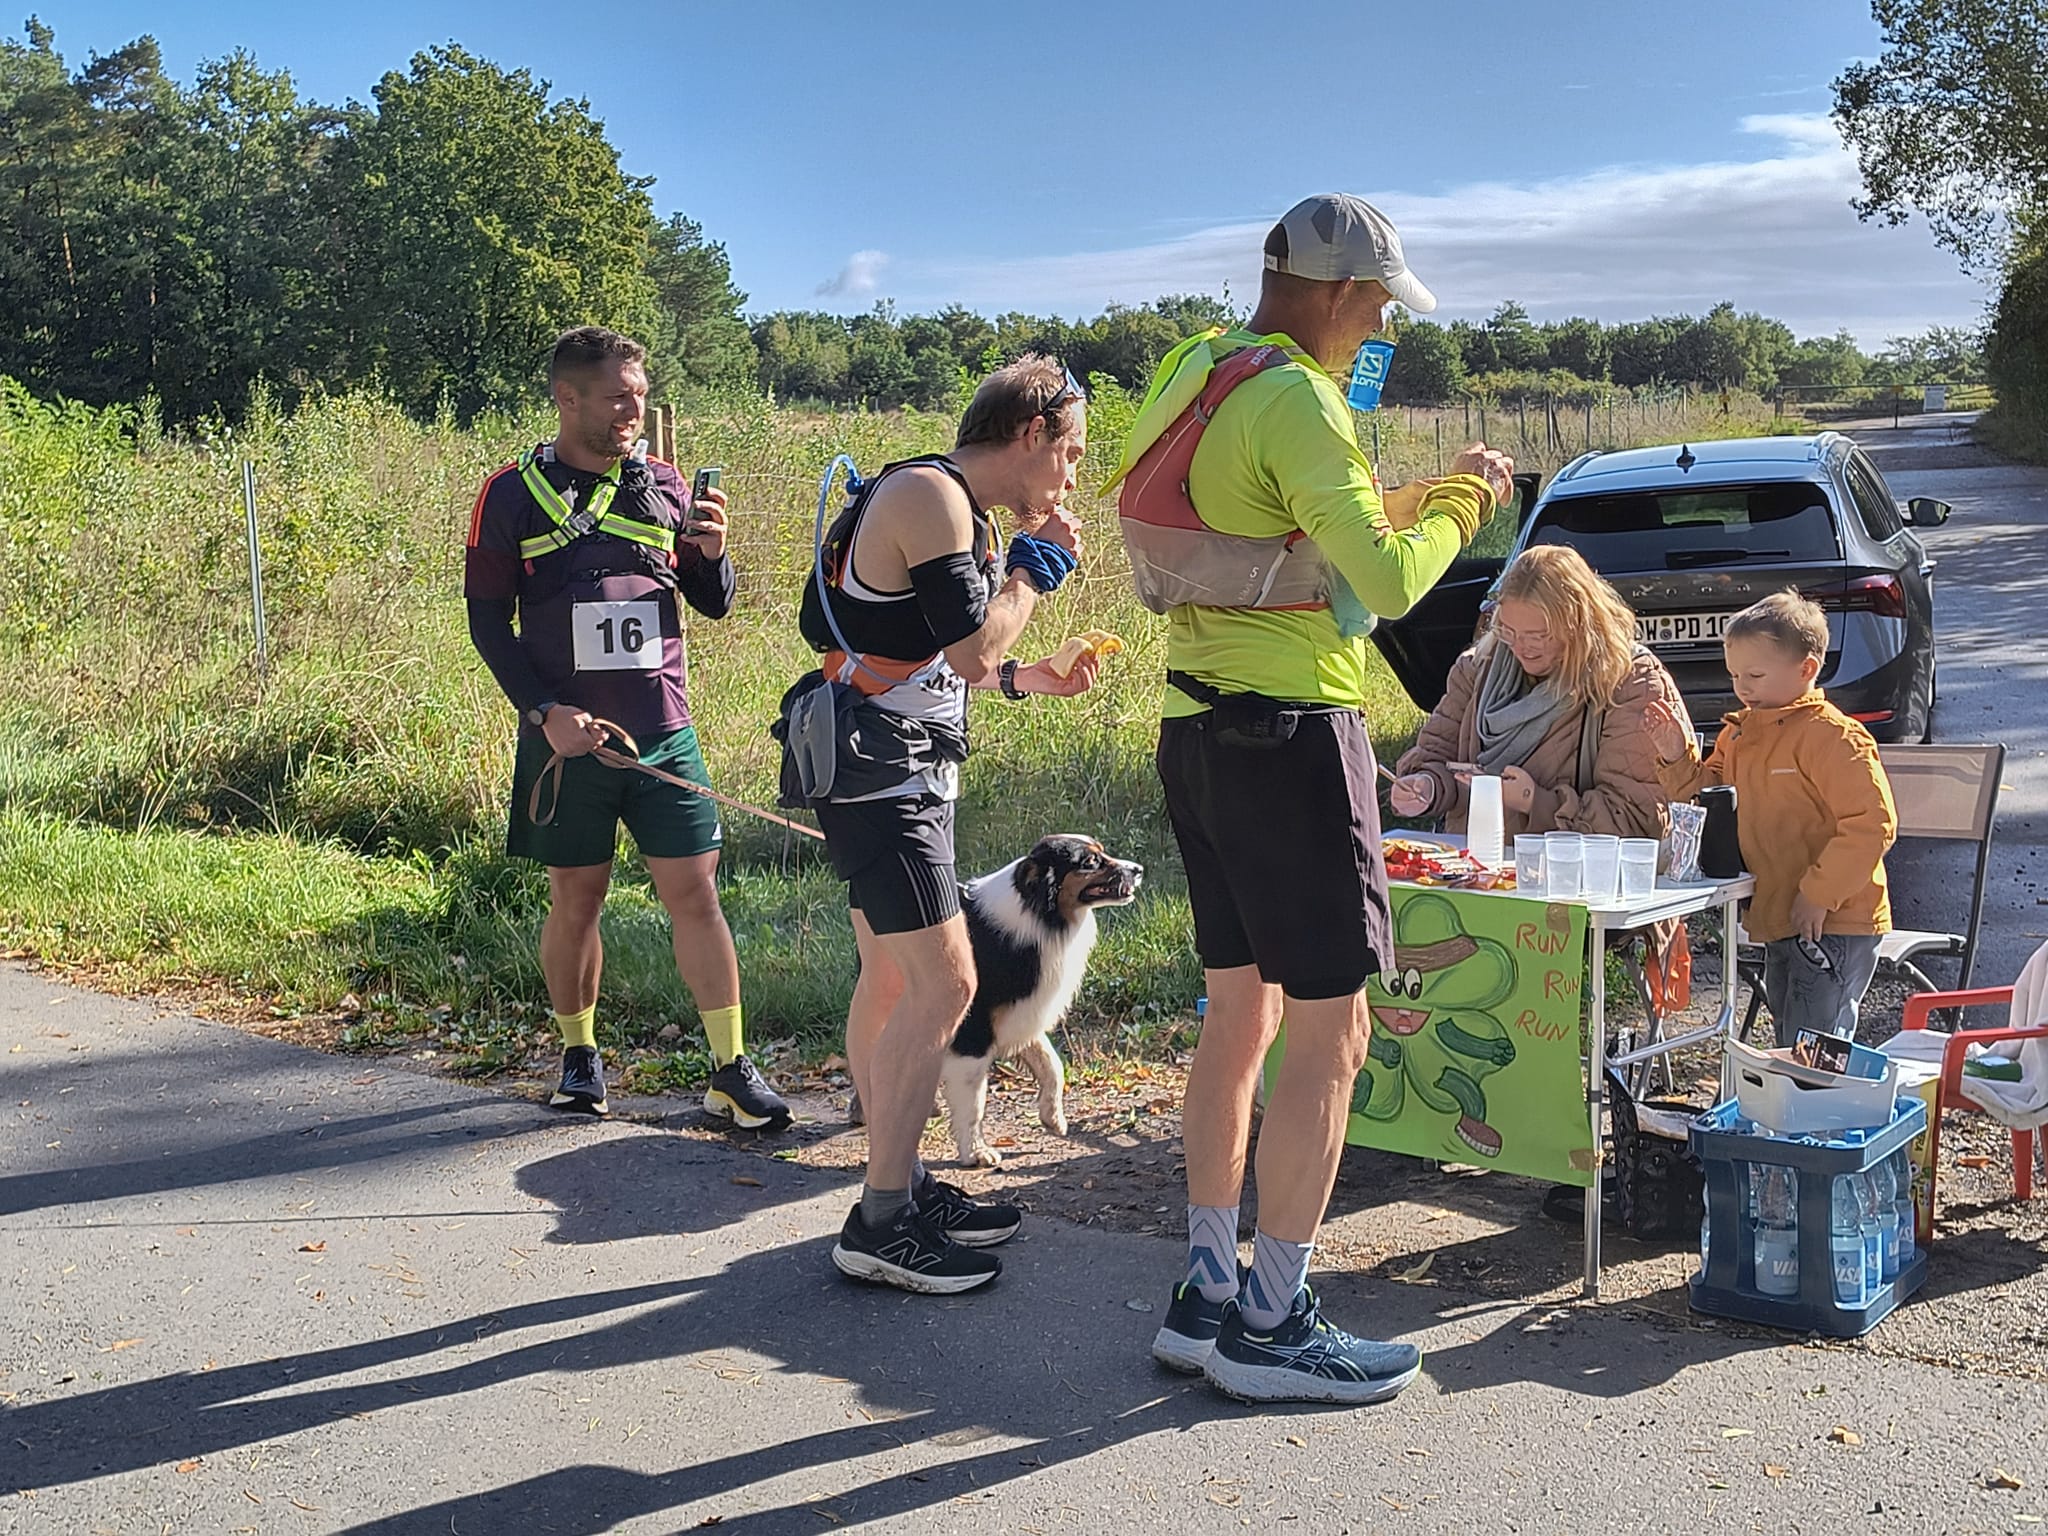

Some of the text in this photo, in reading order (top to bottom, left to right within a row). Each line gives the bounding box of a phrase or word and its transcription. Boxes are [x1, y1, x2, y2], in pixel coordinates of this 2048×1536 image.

[596, 617, 644, 655] 16
[1674, 617, 1700, 640] PD
[1516, 923, 1570, 957] RUN
[1544, 969, 1580, 1003] RUN
[1514, 1009, 1570, 1042] RUN
